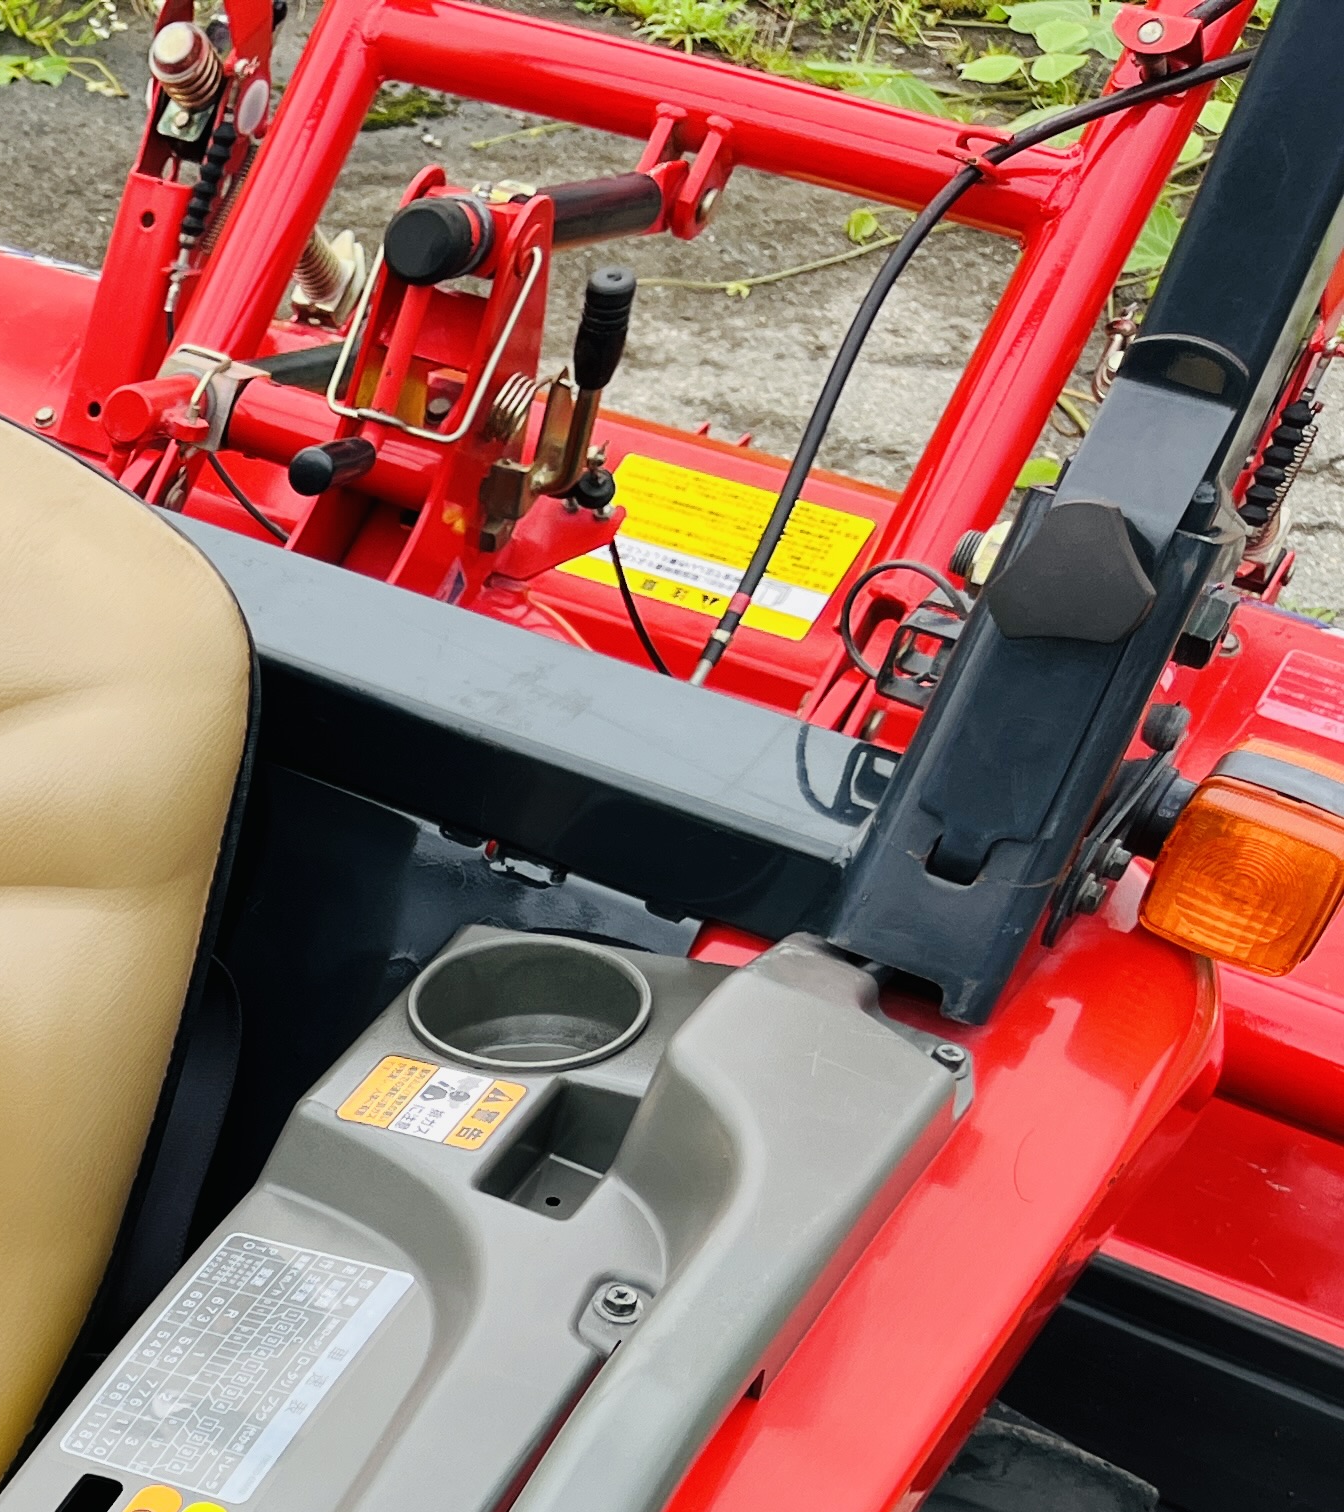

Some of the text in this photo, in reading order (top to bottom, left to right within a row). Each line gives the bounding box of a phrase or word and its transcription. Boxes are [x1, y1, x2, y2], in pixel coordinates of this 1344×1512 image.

[193, 1294, 226, 1324] 673
[221, 1307, 241, 1320] R
[68, 1288, 204, 1450] 681 549 786 1184
[282, 1344, 350, 1417] 車速表
[126, 1377, 159, 1407] 776
[89, 1417, 130, 1457] 1170
[122, 1435, 140, 1447] 3
